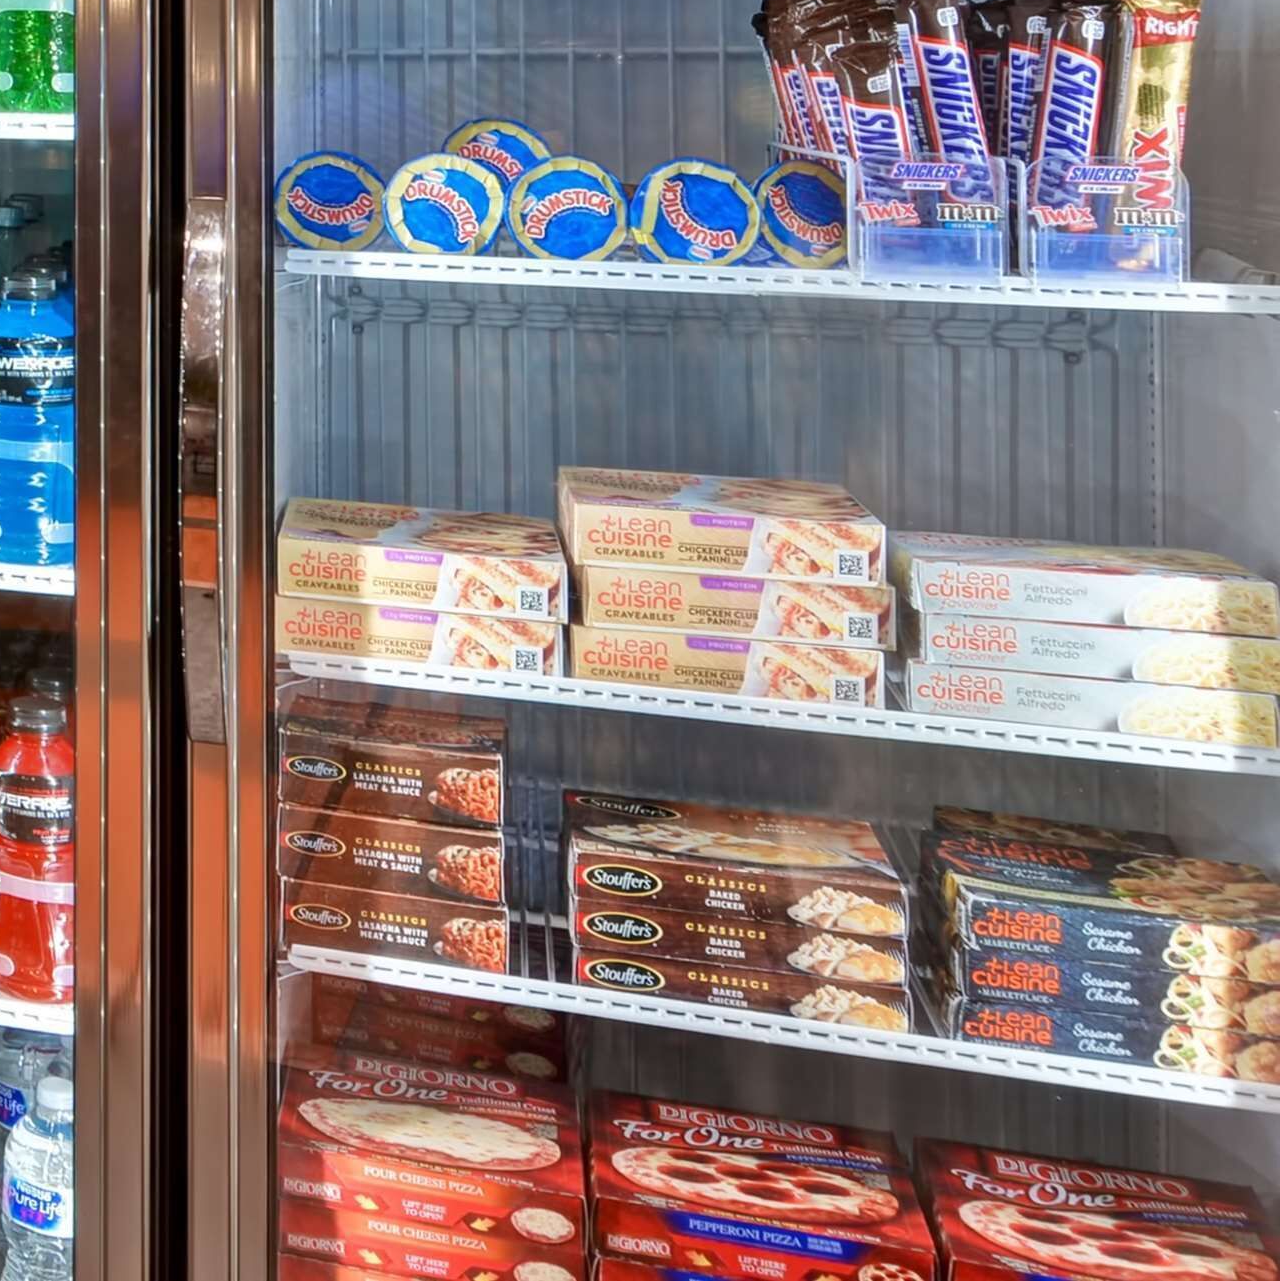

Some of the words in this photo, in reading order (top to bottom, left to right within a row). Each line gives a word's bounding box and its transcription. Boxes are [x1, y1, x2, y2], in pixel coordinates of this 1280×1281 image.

[1144, 18, 1200, 37] RIGHT
[892, 163, 963, 180] SNICKERS
[1066, 166, 1140, 184] SNICKERS
[287, 186, 374, 226] DRUMSTICK
[404, 179, 478, 243] DRUMSTICK
[526, 188, 612, 239] DRUMSTICK
[662, 179, 736, 251] DRUMSTICK
[678, 544, 723, 556] CHICKEN
[695, 553, 732, 565] PANINI
[295, 579, 360, 594] CRAVEABLES
[372, 579, 413, 592] CHICKEN
[390, 588, 423, 599] PANINI
[1023, 582, 1088, 597] Fettuccini
[1025, 593, 1073, 607] Alfredo
[688, 606, 733, 619] CHICKEN
[291, 637, 356, 651] CRAVEABLES
[1031, 635, 1096, 651] Fettuccini
[1031, 646, 1080, 660] Alfredo
[674, 667, 717, 679] CHICKEN
[355, 761, 422, 777] CLASSICS
[352, 772, 396, 785] LASAGNA
[397, 777, 423, 788] WITH
[354, 780, 380, 791] MEAT
[391, 785, 421, 797] SAUCE
[591, 869, 653, 893] Stouffer's
[685, 873, 768, 894] CLASSICS
[709, 889, 741, 901] BAKED
[592, 916, 654, 941] Stouffer's
[685, 922, 768, 941] CLASSICS
[709, 936, 742, 949] BAKED
[1086, 936, 1142, 956] Chicken
[594, 963, 655, 988] Stouffer's
[687, 970, 770, 991] CLASSICS
[1085, 987, 1140, 1007] Chicken
[309, 1069, 375, 1098] For
[371, 1076, 448, 1104] One
[611, 1118, 682, 1147] For
[682, 1125, 765, 1152] One
[363, 1165, 397, 1184] FOUR
[397, 1171, 447, 1192] CHEESE
[447, 1178, 485, 1198] PIZZA
[950, 1167, 1028, 1197] For
[1028, 1181, 1116, 1209] One
[450, 1233, 488, 1253] PIZZA
